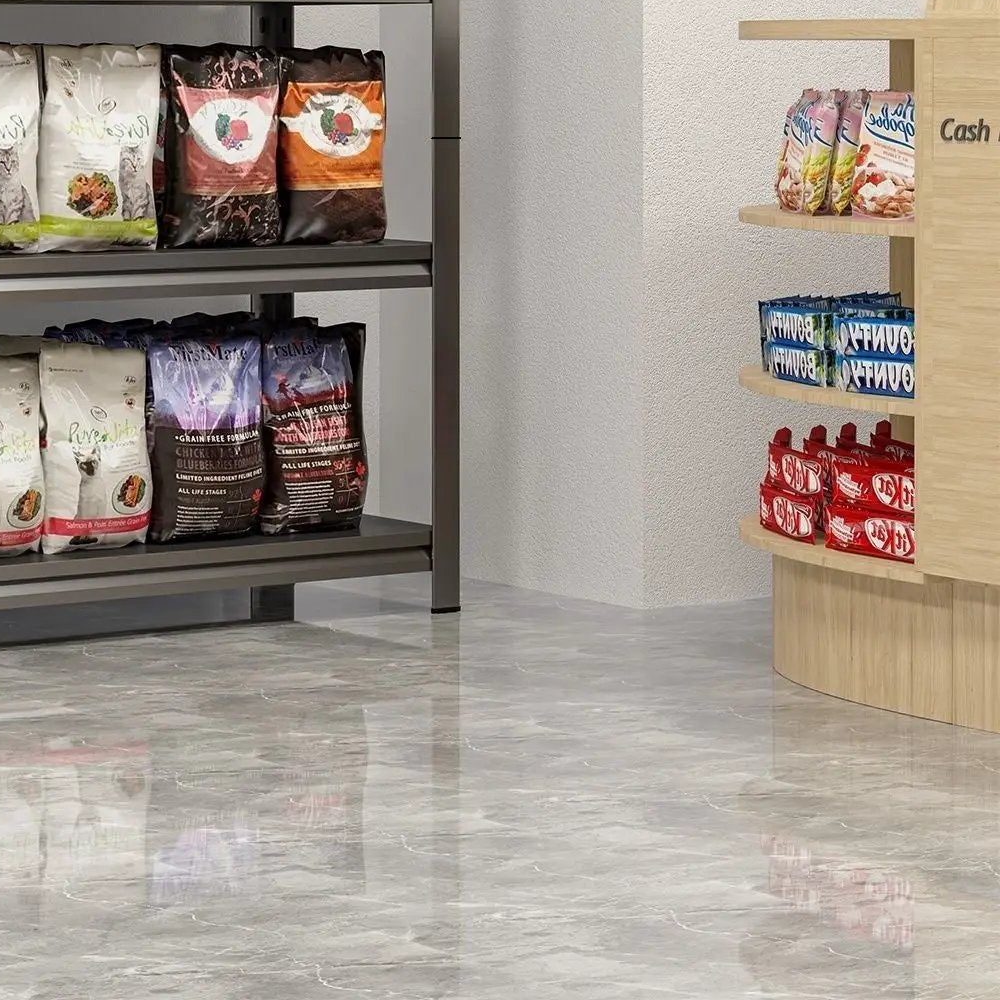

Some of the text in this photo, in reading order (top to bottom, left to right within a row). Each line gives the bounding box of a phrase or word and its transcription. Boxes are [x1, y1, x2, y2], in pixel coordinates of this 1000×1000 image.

[940, 118, 990, 142] Cash
[227, 430, 257, 441] FORMULA
[176, 474, 202, 482] LIMITED
[66, 521, 88, 529] Salmon
